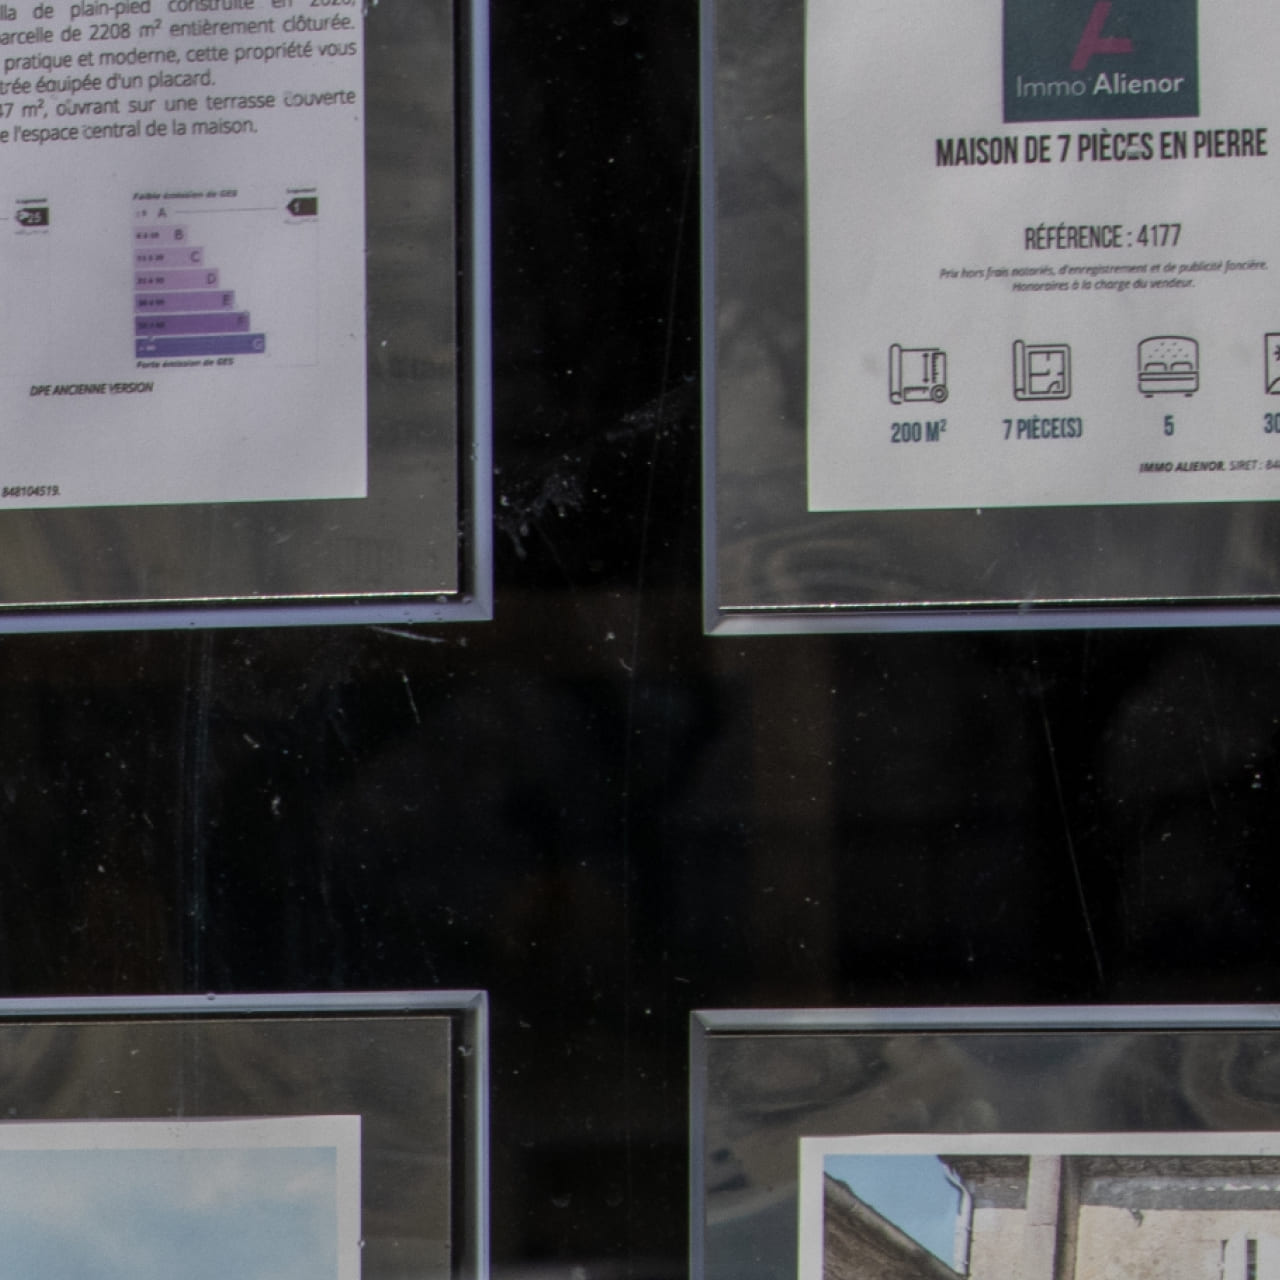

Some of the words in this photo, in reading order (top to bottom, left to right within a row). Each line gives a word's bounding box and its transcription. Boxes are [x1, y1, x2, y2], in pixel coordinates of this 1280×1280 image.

[1016, 75, 1087, 97] Immo
[1092, 71, 1185, 96] Alienor
[13, 125, 80, 146] l'espace
[144, 119, 168, 138] de
[171, 118, 188, 136] la
[191, 117, 258, 136] maison.
[935, 135, 1019, 167] MAISON
[1024, 134, 1052, 164] DE
[1056, 133, 1072, 163] 7
[1077, 127, 1154, 163] PIÈCES
[1159, 130, 1188, 160] EN
[1193, 127, 1269, 159] PIERRE
